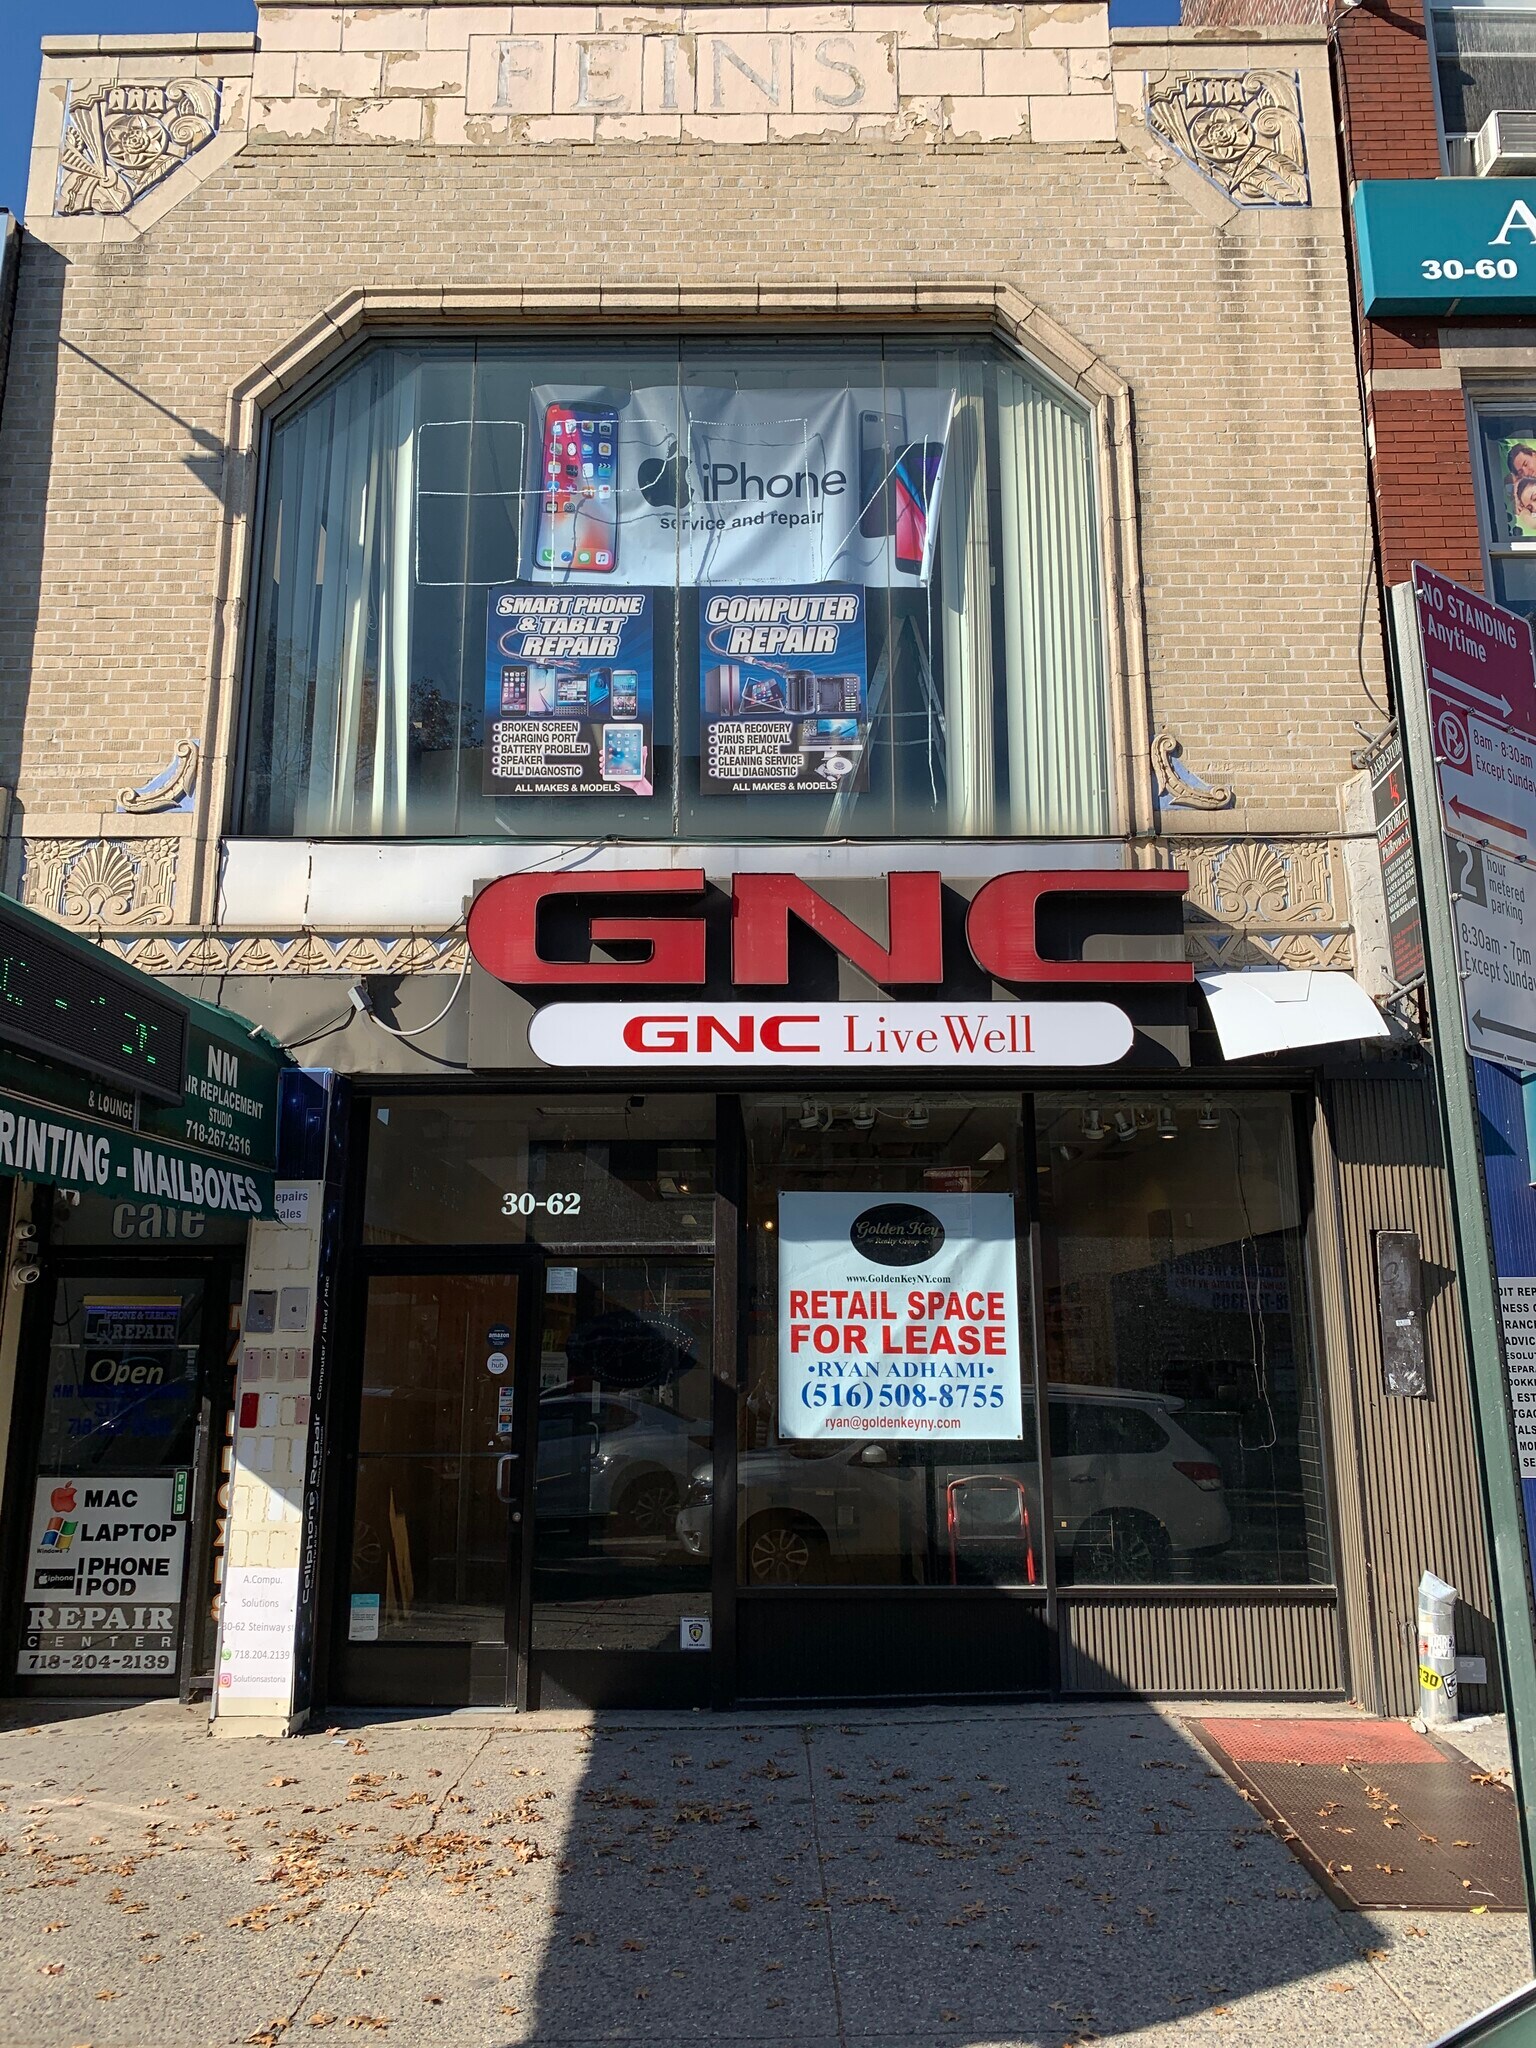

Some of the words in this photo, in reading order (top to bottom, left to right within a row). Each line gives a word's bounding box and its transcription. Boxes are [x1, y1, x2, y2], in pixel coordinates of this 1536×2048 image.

[494, 38, 866, 109] FEINS
[1421, 259, 1518, 280] 30-60
[702, 462, 846, 502] iPhone
[660, 516, 726, 531] service
[732, 511, 764, 528] and
[771, 510, 823, 528] repair
[498, 596, 572, 615] SMART
[573, 595, 643, 615] PHONE
[707, 596, 857, 623] COMPUTER
[1422, 581, 1443, 611] NO
[1448, 595, 1517, 649] STANDING
[518, 617, 537, 632] &
[540, 617, 625, 634] TABLET
[521, 636, 619, 656] REPAIR
[729, 626, 837, 654] REPAIR
[1428, 614, 1487, 662] Anytime
[501, 723, 540, 732] BROKEN
[542, 723, 579, 732] SCREEN
[718, 724, 742, 733] DATA
[745, 724, 791, 733] RECOVERY
[501, 734, 550, 743] CHARGING
[552, 734, 576, 743] PORT
[718, 735, 744, 744] VIRUS
[747, 735, 790, 744] REMOVAL
[1473, 729, 1493, 751] 8am
[1501, 742, 1533, 768] 8:30am
[501, 745, 542, 754] BATTERY
[544, 745, 589, 754] PROBLEM
[718, 746, 736, 754] FAN
[739, 745, 779, 754] REPLACE
[500, 756, 543, 764] SPEAKER
[718, 757, 762, 766] CLEANING
[765, 756, 802, 765] SERVICE
[1476, 754, 1505, 781] Except
[501, 767, 523, 776] FULL
[525, 767, 581, 776] DIAGNOSTIC
[719, 768, 740, 776] FULL
[742, 767, 796, 776] DIAGNOSTIC
[515, 784, 533, 792] ALL
[535, 784, 569, 792] MAKES
[571, 784, 578, 792] &
[580, 784, 620, 792] MODELS
[732, 783, 750, 791] ALL
[752, 783, 786, 791] MAKES
[797, 781, 838, 790] MODELS
[1456, 841, 1478, 898] 2
[1486, 855, 1507, 877] hour
[1489, 877, 1525, 903] metered
[1491, 899, 1524, 925] parking
[466, 867, 1194, 984] GNC
[1462, 923, 1501, 950] 8:30am
[1510, 941, 1532, 966] 7pm
[1465, 951, 1501, 983] Except
[622, 1015, 820, 1052] GNC
[207, 1045, 238, 1088] NM
[88, 1091, 95, 1107] &
[98, 1094, 133, 1121] LOUNGE
[200, 1080, 263, 1120] REPLACEMENT
[208, 1106, 233, 1129] STUDIO
[186, 1120, 251, 1156] 718-267-2516
[133, 1147, 263, 1213] MAILBOXES
[275, 1191, 308, 1203] epairs
[501, 1192, 581, 1215] 30-62
[856, 1221, 905, 1239] Golden
[906, 1221, 940, 1237] Key
[846, 1274, 951, 1284] www.GoldenKeyNY.com
[790, 1290, 897, 1319] RETAIL
[908, 1291, 1006, 1321] SPACE
[111, 1324, 174, 1339] REPAIR
[790, 1324, 868, 1353] FOR
[882, 1325, 1007, 1355] LEASE
[90, 1359, 163, 1385] Open
[818, 1362, 879, 1378] RYAN
[886, 1362, 986, 1378] ADHAMI
[1508, 1365, 1536, 1373] REPAR
[825, 1416, 961, 1431] ryan@goldenkeyny.com
[302, 1491, 315, 1604] Cellphone
[310, 1413, 320, 1485] Repair
[316, 1344, 326, 1401] Computer
[84, 1490, 138, 1507] MAC
[81, 1524, 177, 1541] LAPTOP
[48, 1574, 73, 1583] iphone
[241, 1598, 279, 1608] Solutions
[27, 1607, 174, 1629] REPAIR
[248, 1622, 286, 1633] Steinway
[27, 1636, 171, 1648] CENTER
[28, 1655, 170, 1670] 718-204-2139
[234, 1650, 290, 1660] 718.204.2139
[233, 1675, 286, 1684] Solutionsastoria
